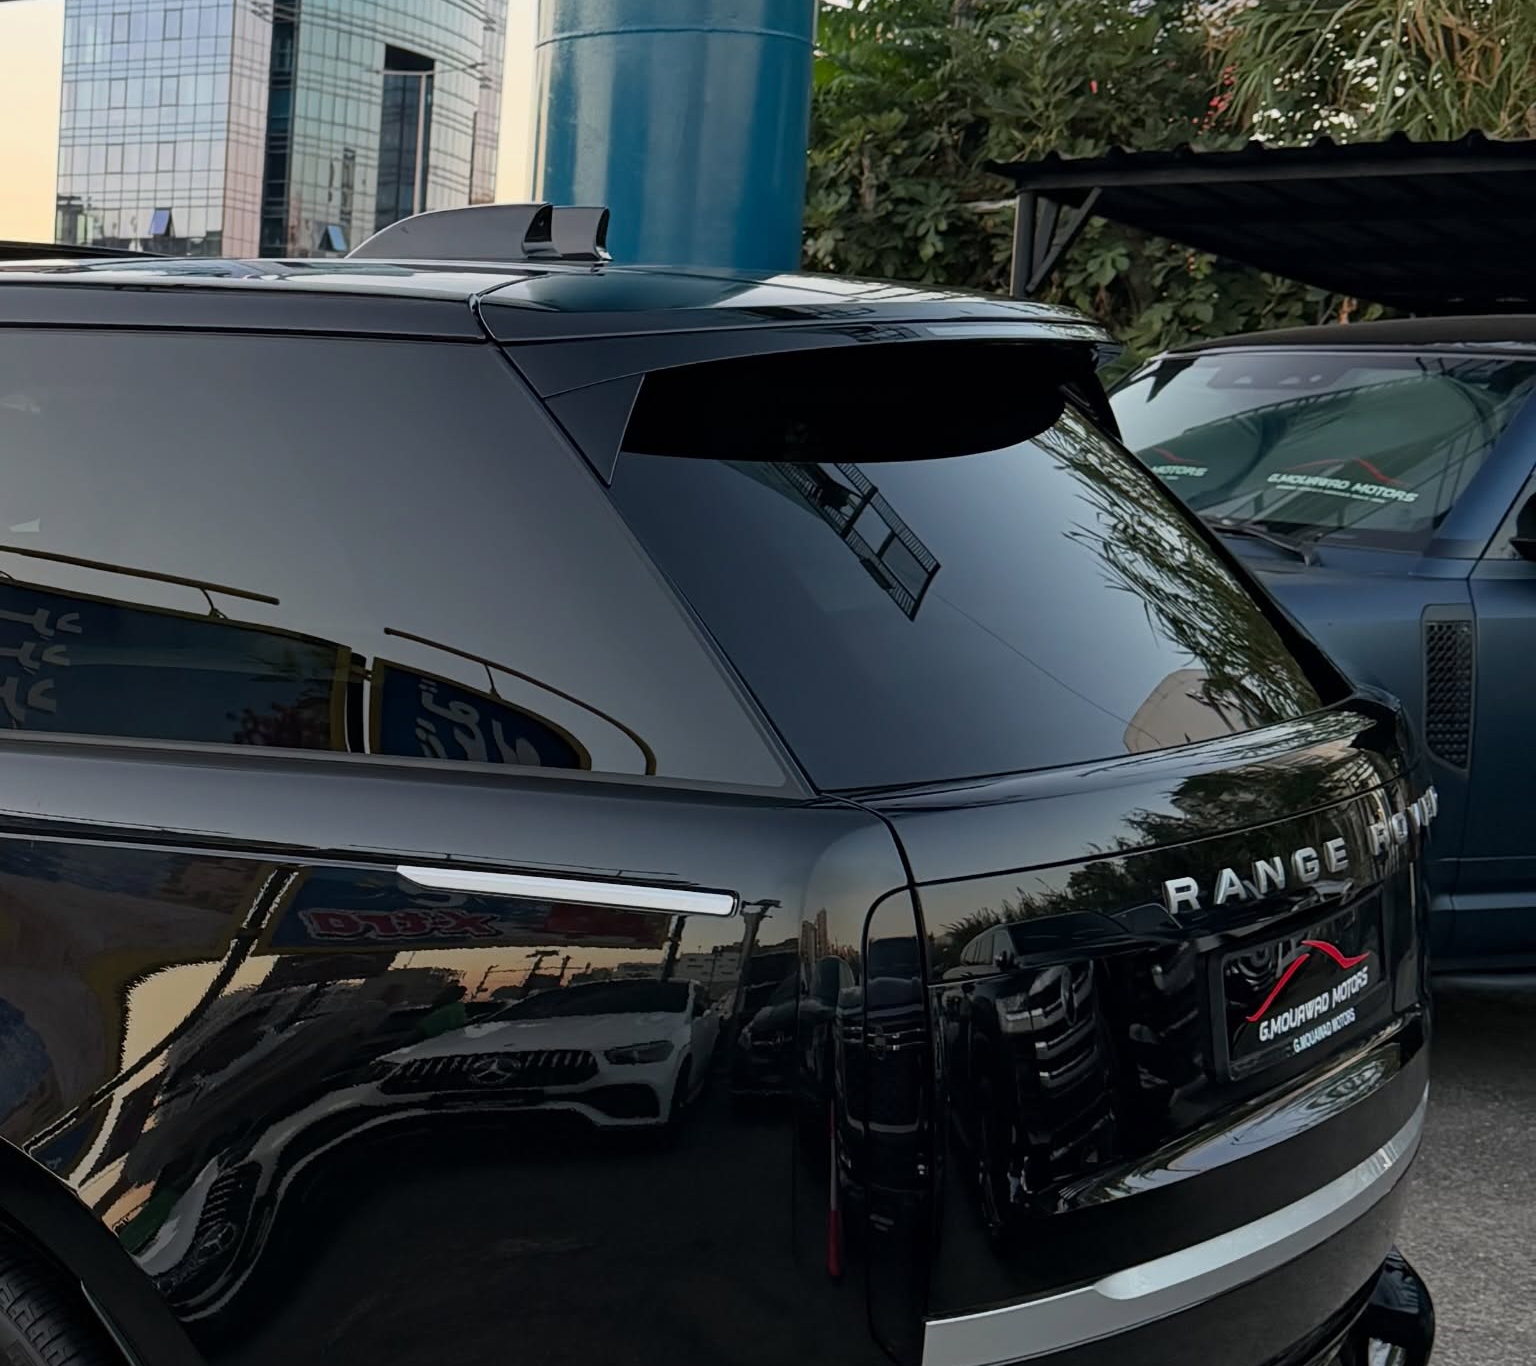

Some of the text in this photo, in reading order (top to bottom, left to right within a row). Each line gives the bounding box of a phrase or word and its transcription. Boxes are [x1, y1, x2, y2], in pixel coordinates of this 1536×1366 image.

[1352, 482, 1419, 503] MOTORS
[1164, 837, 1351, 915] RANGE
[1259, 966, 1368, 1041] G.MOUAWAD MOTORS
[1332, 1007, 1356, 1032] MOTORS
